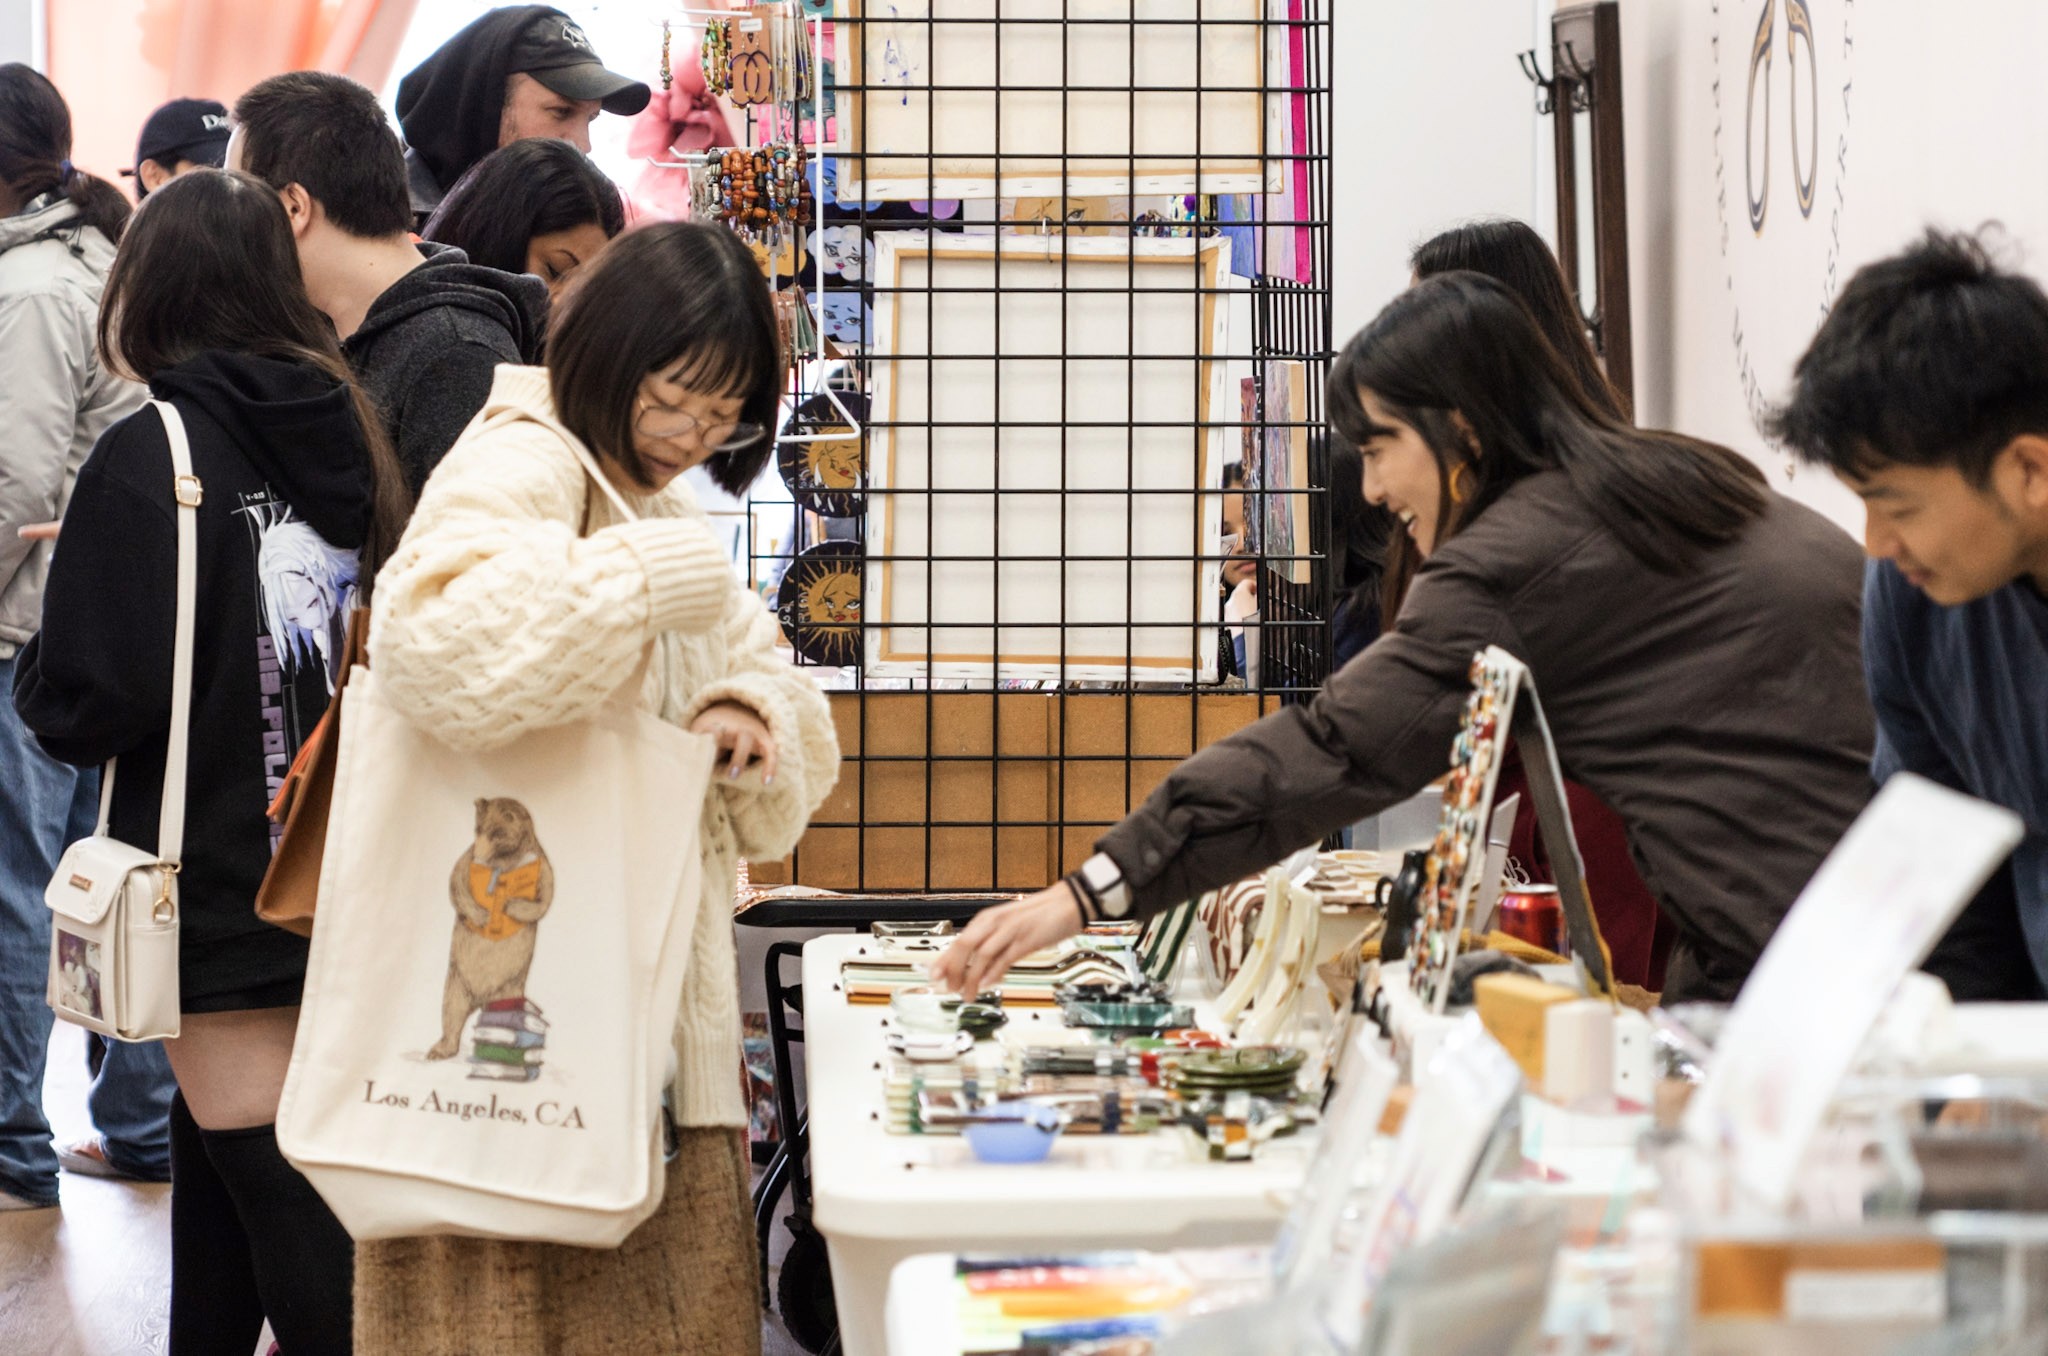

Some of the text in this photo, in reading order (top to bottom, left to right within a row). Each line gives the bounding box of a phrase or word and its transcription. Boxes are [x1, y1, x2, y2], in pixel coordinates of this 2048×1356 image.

[363, 1080, 585, 1129] Los Angeles, CA
